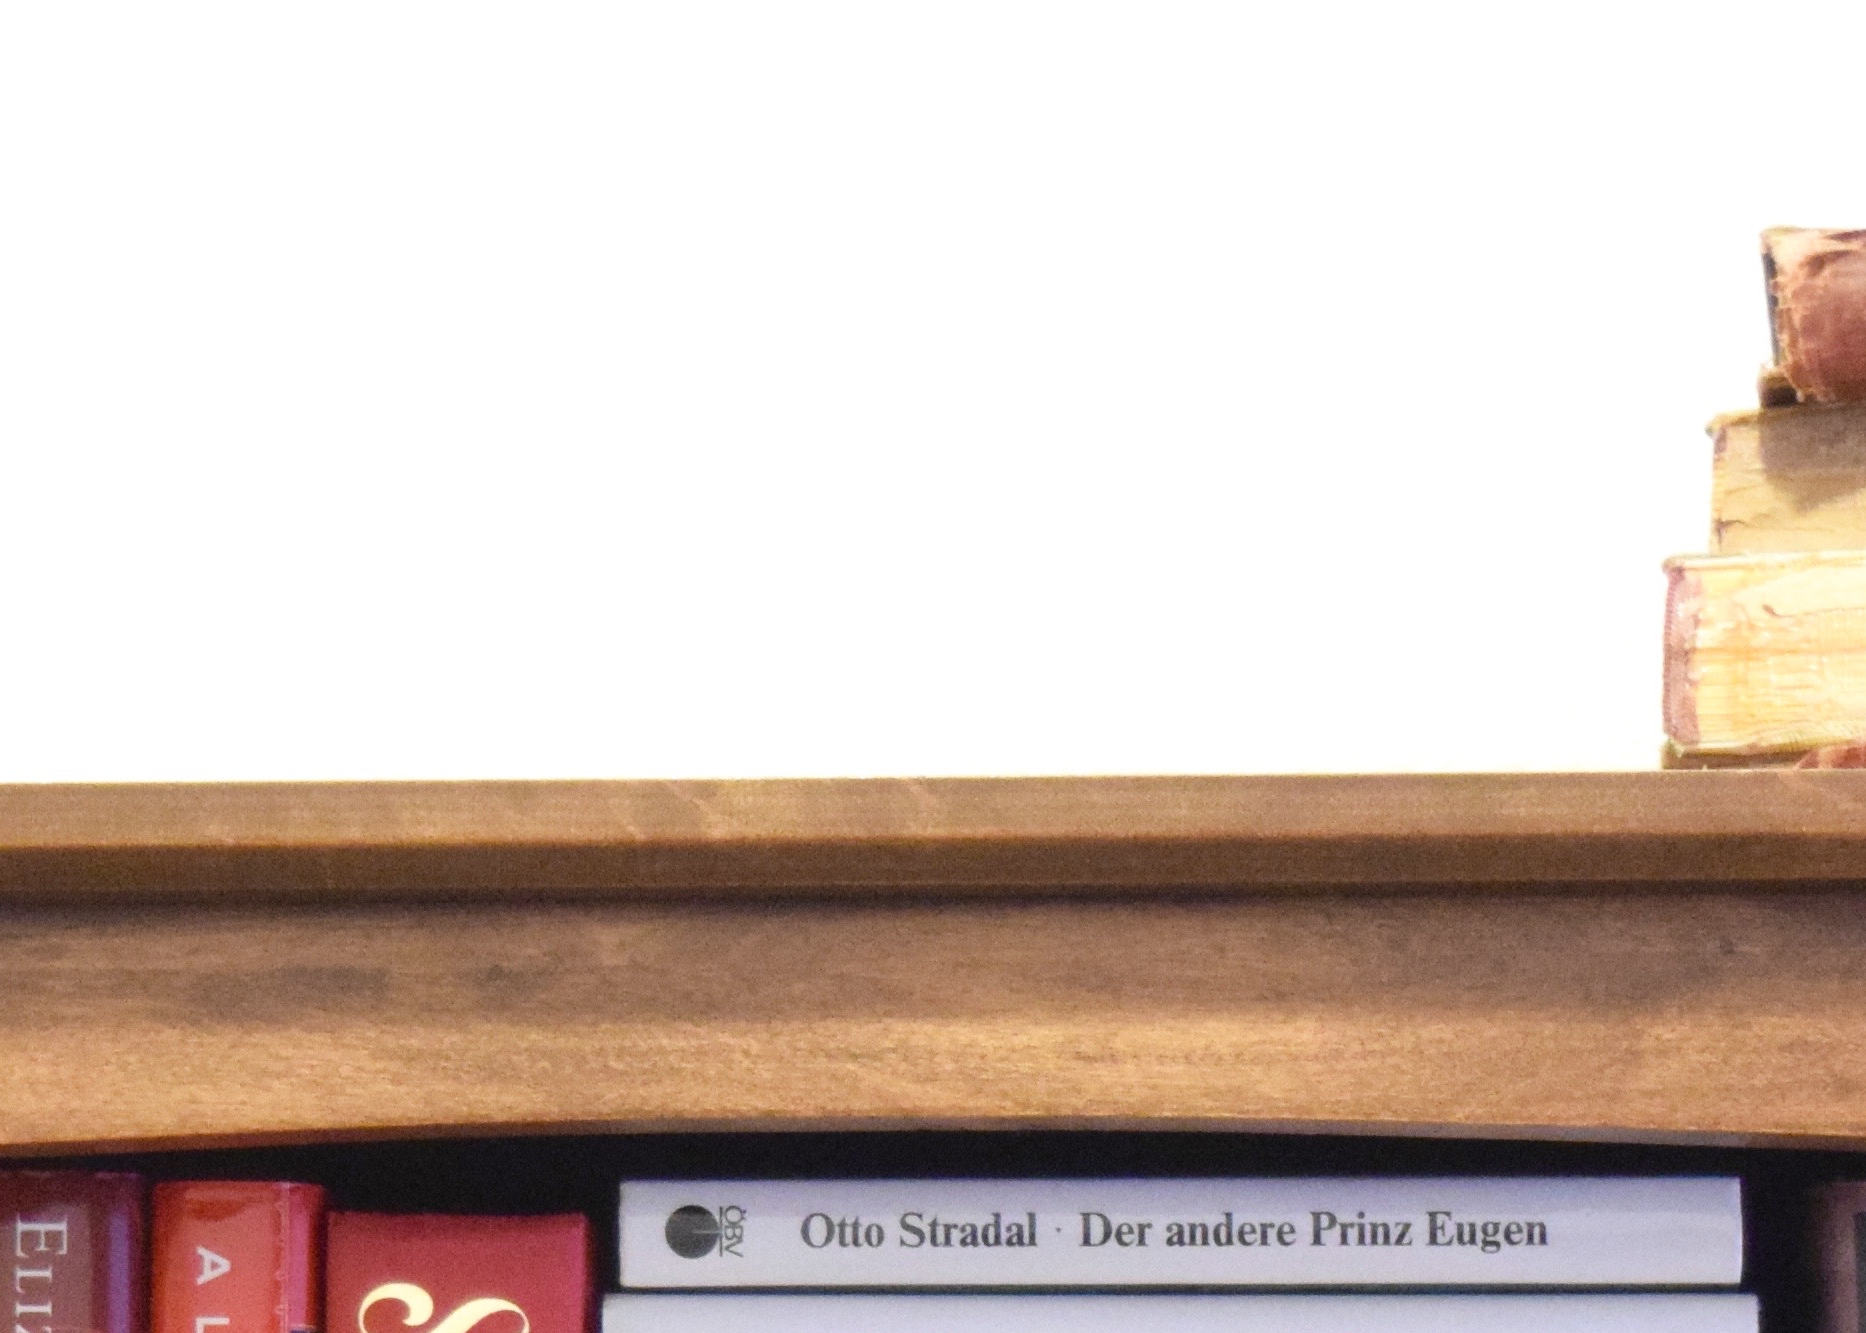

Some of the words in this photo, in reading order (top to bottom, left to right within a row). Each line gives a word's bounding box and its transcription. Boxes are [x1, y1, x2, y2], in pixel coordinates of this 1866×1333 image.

[801, 1213, 884, 1249] Otto
[900, 1212, 1038, 1249] Stradal
[1079, 1212, 1152, 1248] Der
[1165, 1210, 1296, 1248] andere
[1310, 1211, 1412, 1247] Prinz
[1425, 1212, 1548, 1252] Eugen
